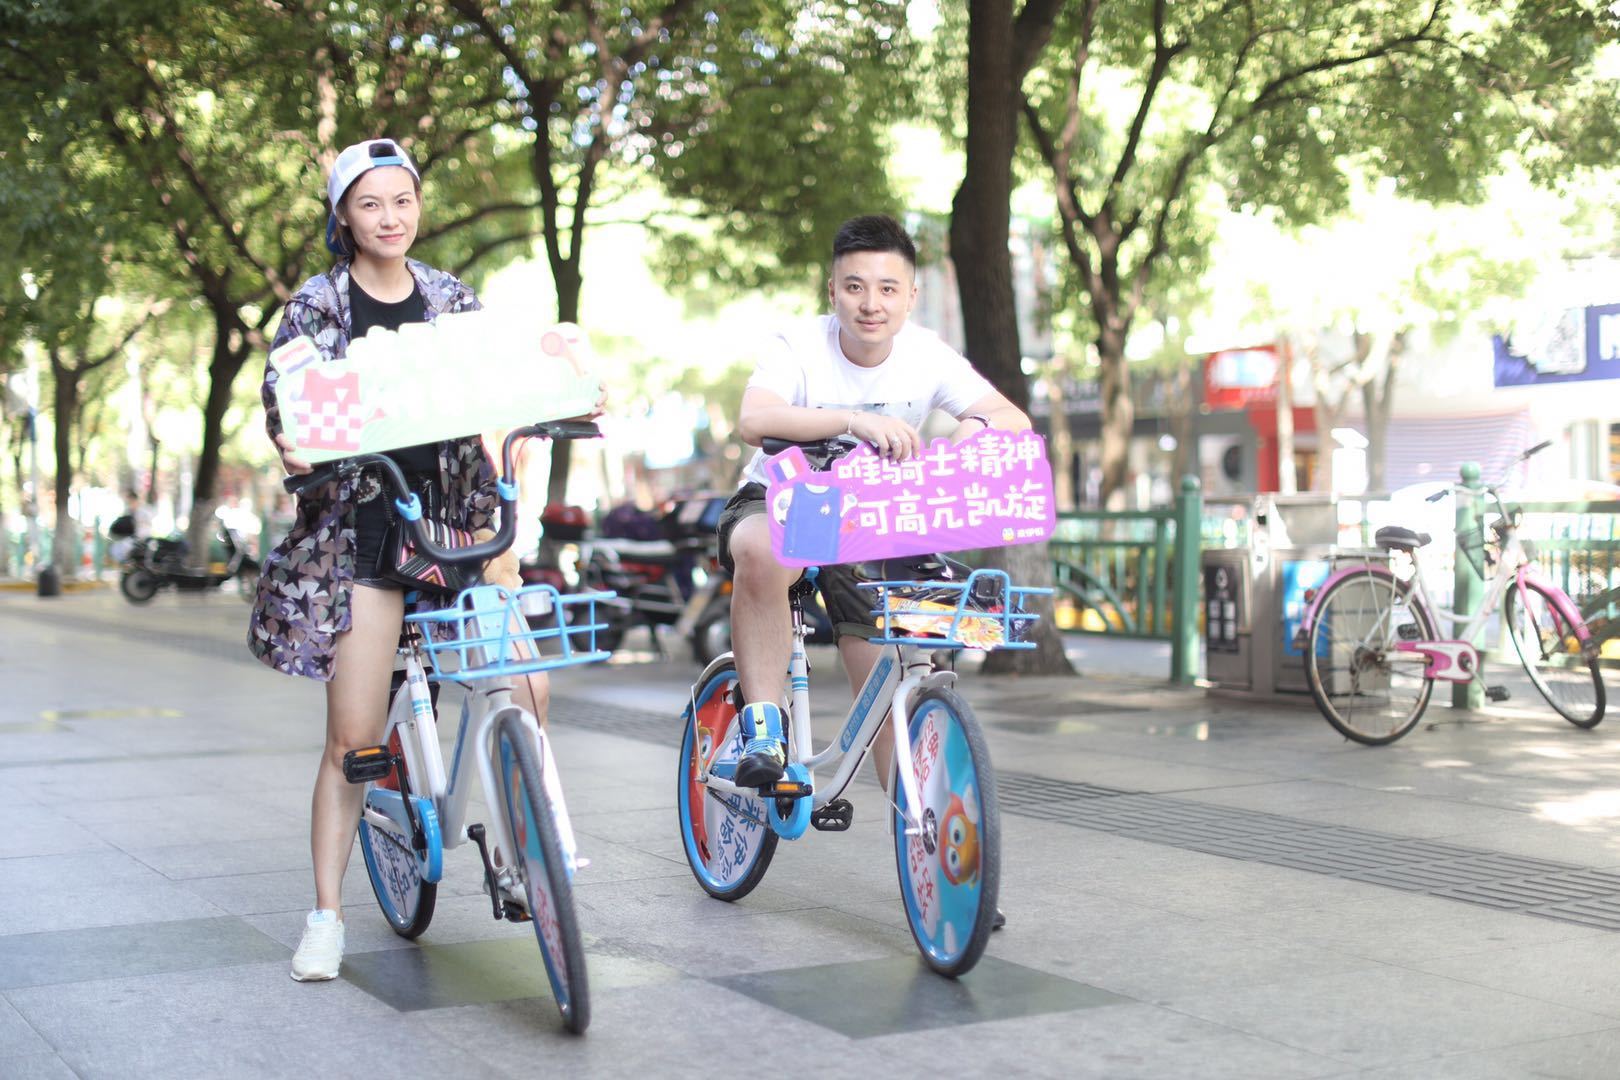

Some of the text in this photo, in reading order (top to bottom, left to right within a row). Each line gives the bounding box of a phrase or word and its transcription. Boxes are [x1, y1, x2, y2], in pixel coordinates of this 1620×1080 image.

[838, 434, 1041, 486] 唯骑士精神
[858, 479, 1047, 536] 可高亢凯旋
